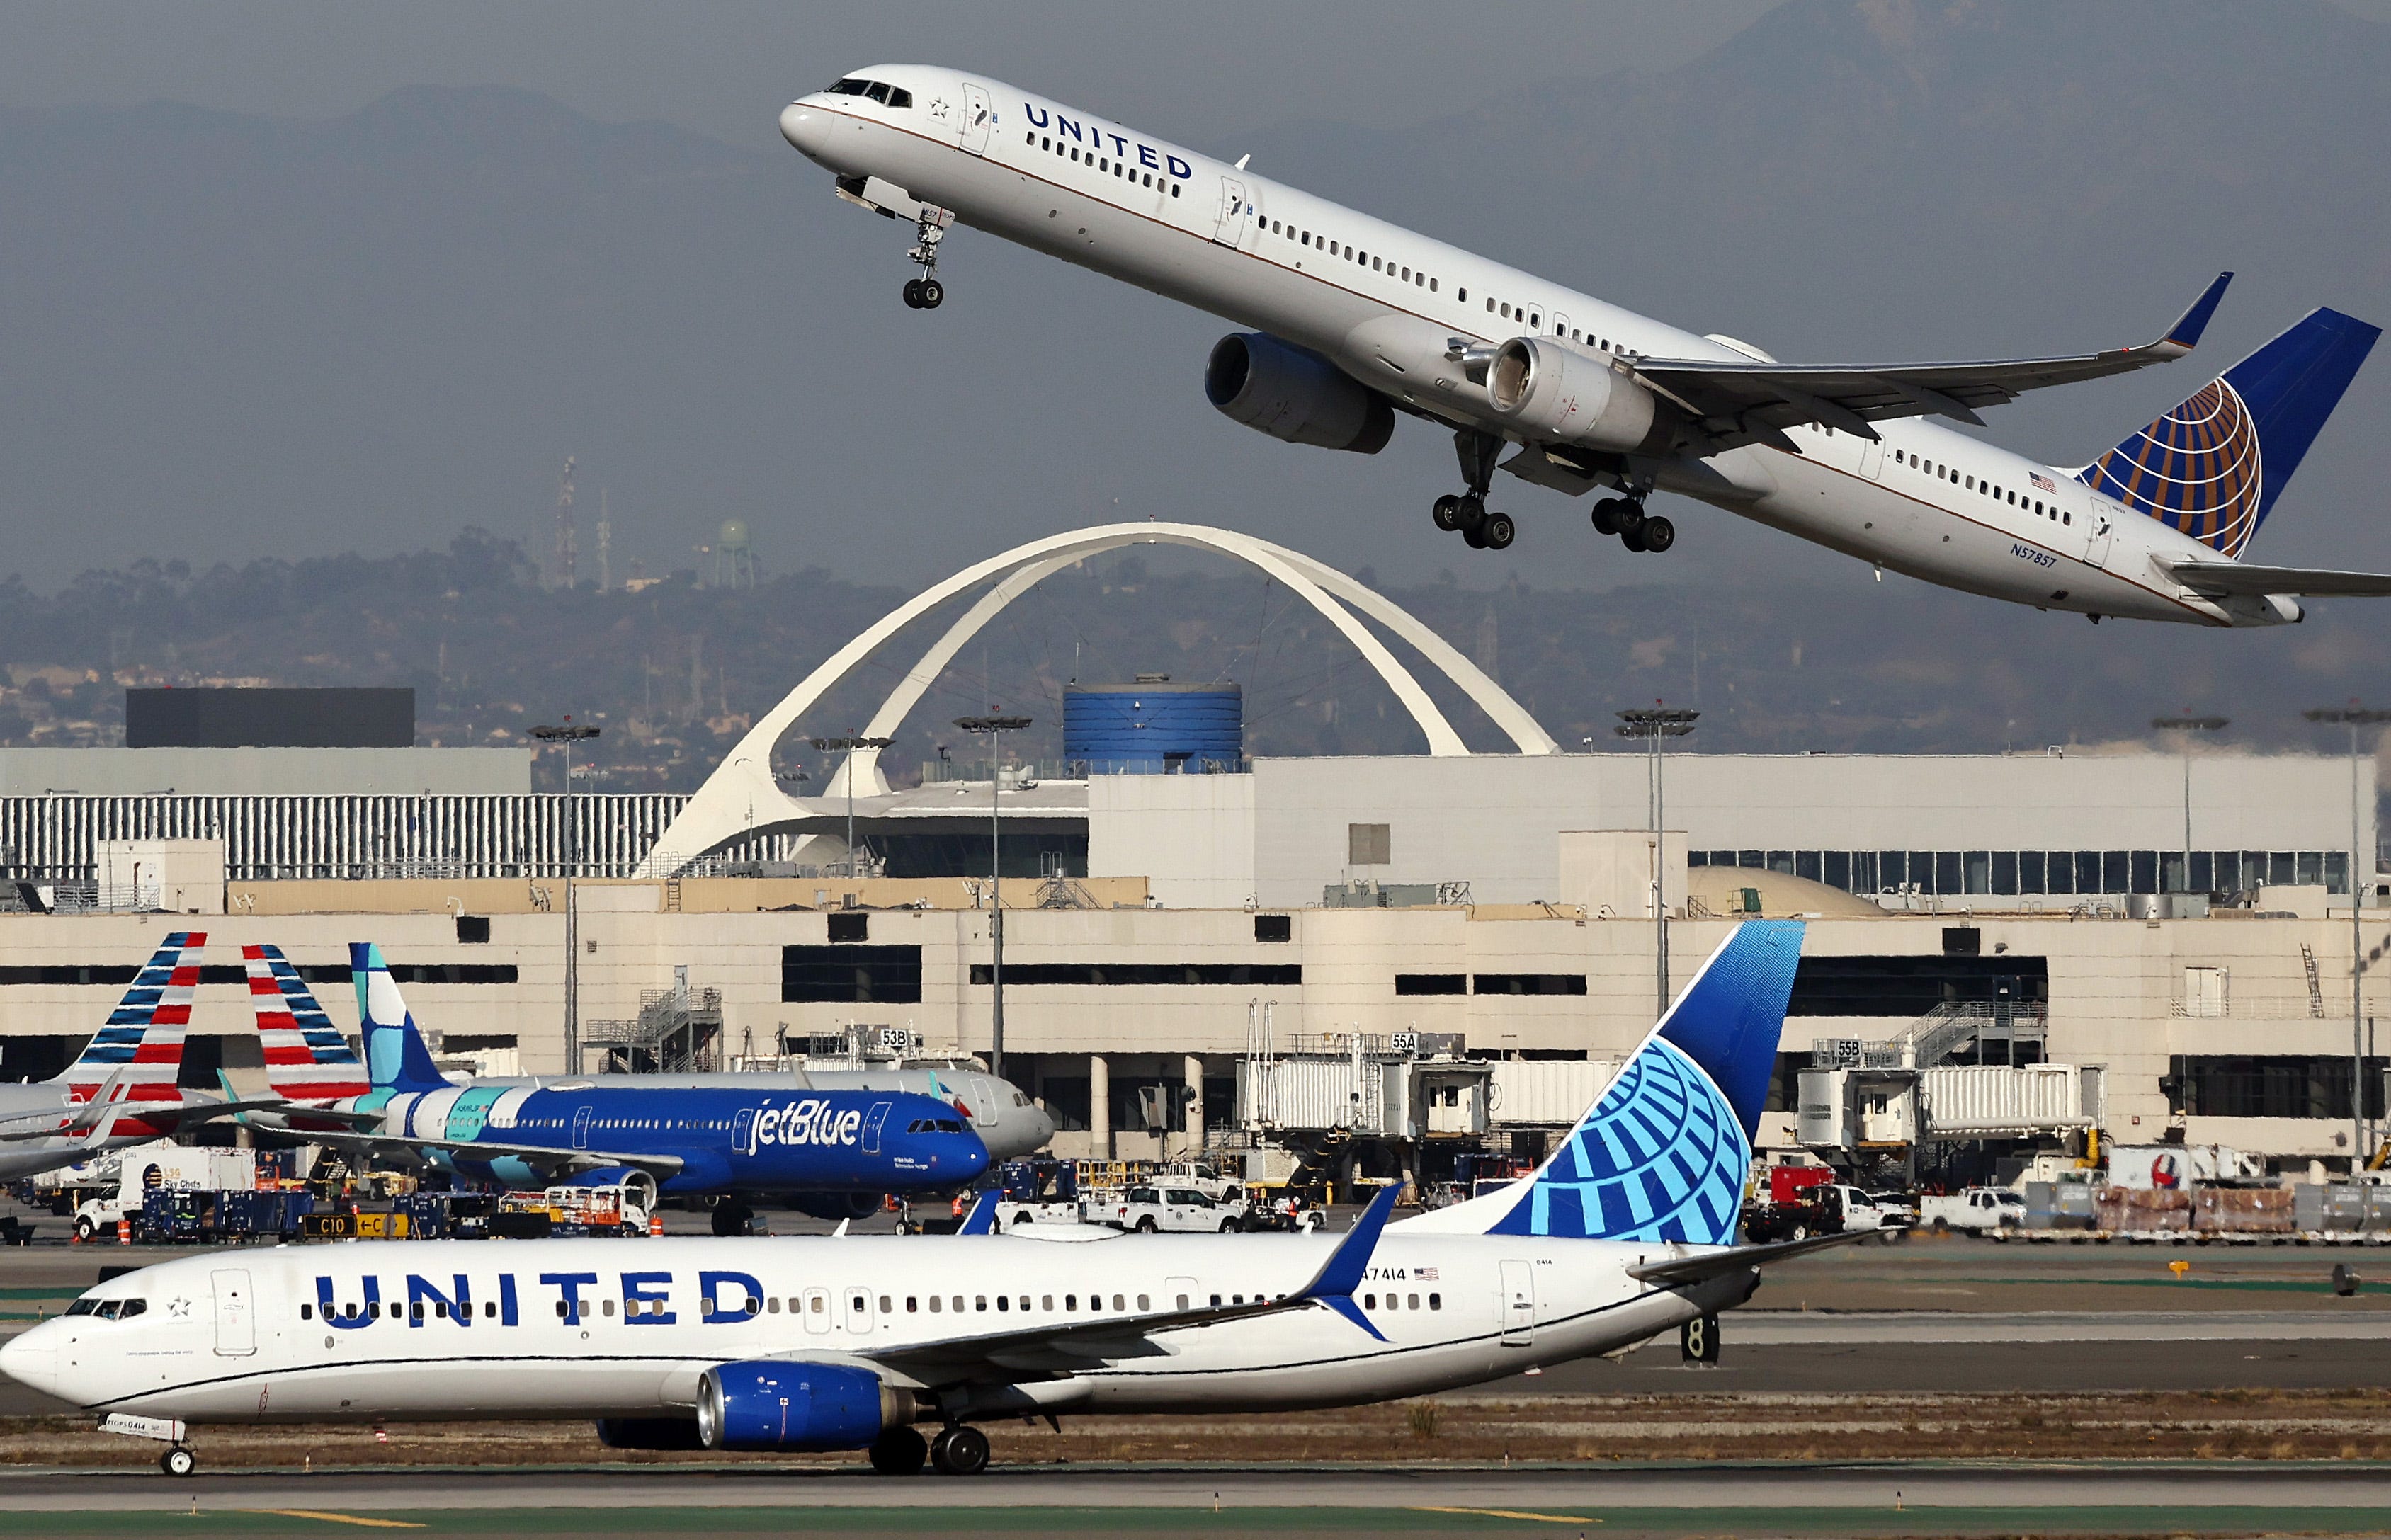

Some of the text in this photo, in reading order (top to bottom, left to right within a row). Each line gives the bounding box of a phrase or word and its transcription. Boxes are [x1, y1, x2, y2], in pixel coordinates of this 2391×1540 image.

[1024, 103, 1192, 180] UNITED
[2010, 543, 2057, 568] N57857
[883, 1030, 907, 1045] 53B
[1393, 1034, 1416, 1049] 55A
[1839, 1041, 1860, 1056] 55B
[748, 1098, 861, 1156] jetBlue
[164, 1168, 181, 1177] LSG
[164, 1180, 201, 1189] Sky Chefs
[321, 1219, 346, 1233] C10
[373, 1218, 381, 1232] C
[1361, 1267, 1406, 1280] 47414
[316, 1271, 764, 1329] UNITED
[1688, 1318, 1704, 1357] 8
[127, 1422, 145, 1430] 0414
